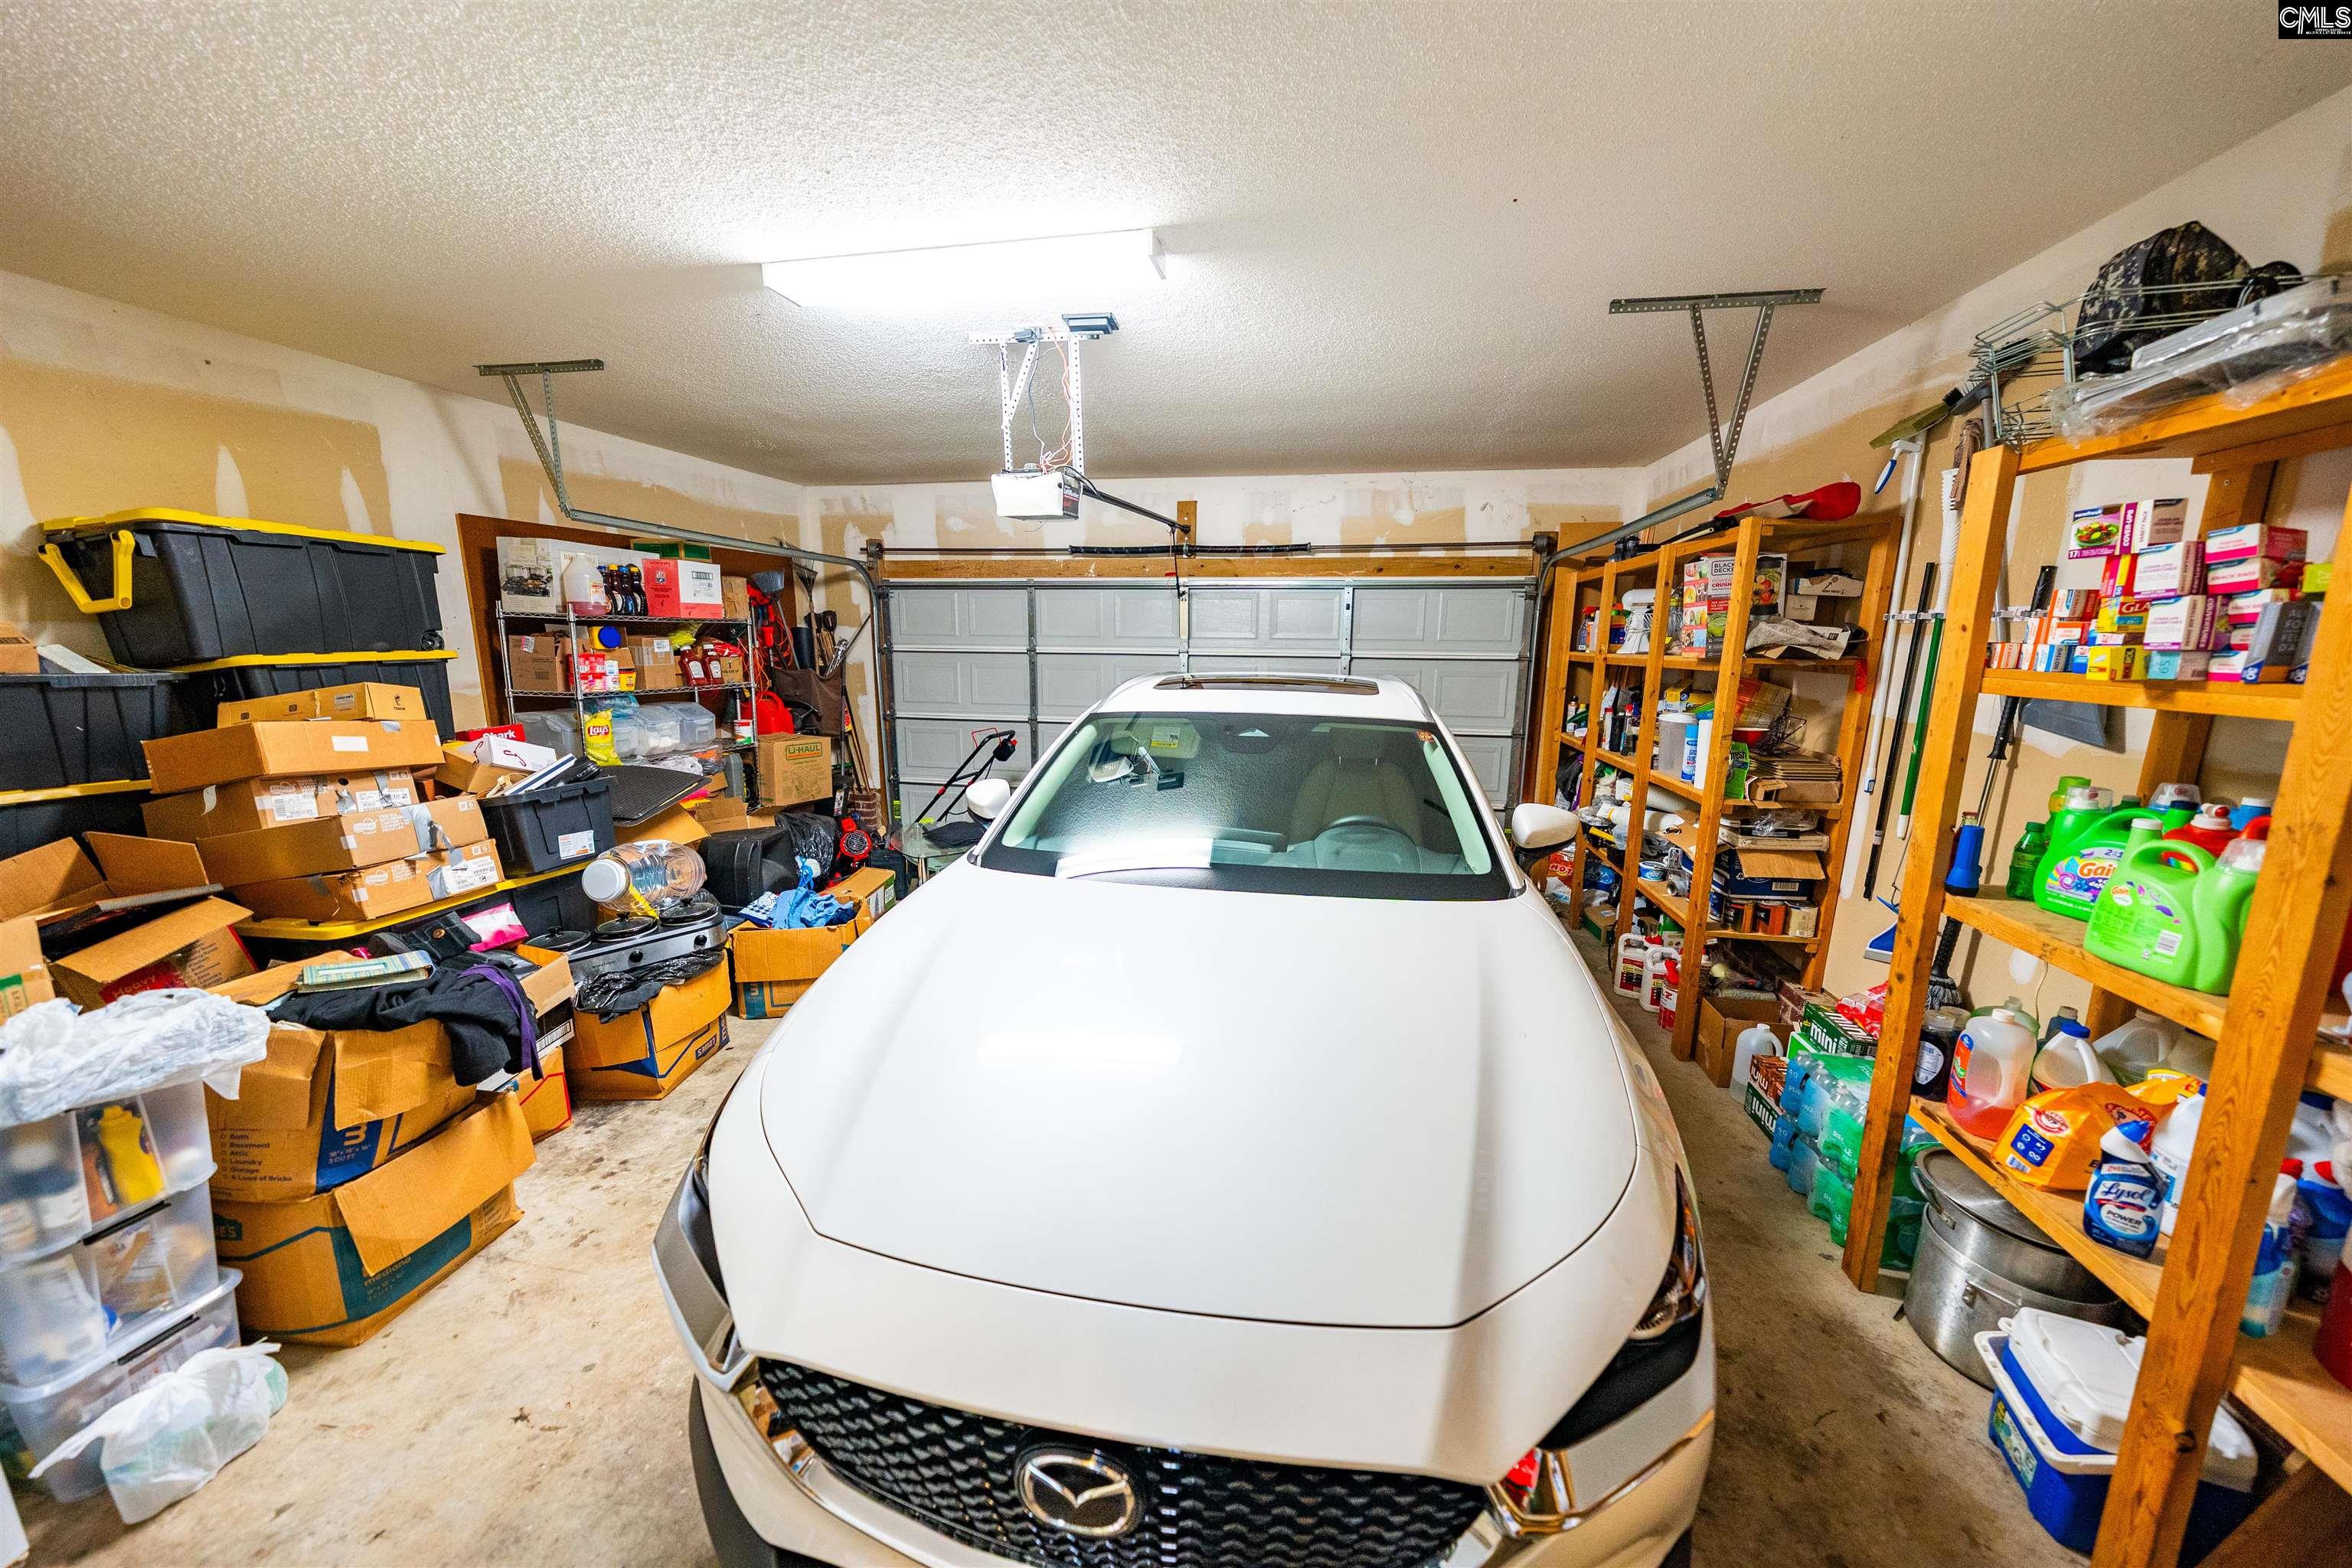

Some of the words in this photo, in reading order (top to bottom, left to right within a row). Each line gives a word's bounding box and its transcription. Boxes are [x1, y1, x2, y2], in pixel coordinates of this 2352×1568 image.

[2122, 509, 2135, 547] COVER-UPS
[2122, 603, 2151, 612] GLA
[788, 744, 821, 754] U-HAUL
[1550, 863, 1573, 875] HOT
[2112, 887, 2129, 895] Gain
[1811, 1022, 1838, 1054] mini
[344, 1122, 368, 1146] 3
[231, 1166, 260, 1174] Garage
[2101, 1182, 2151, 1201] Lysol
[2107, 1210, 2142, 1226] POWER
